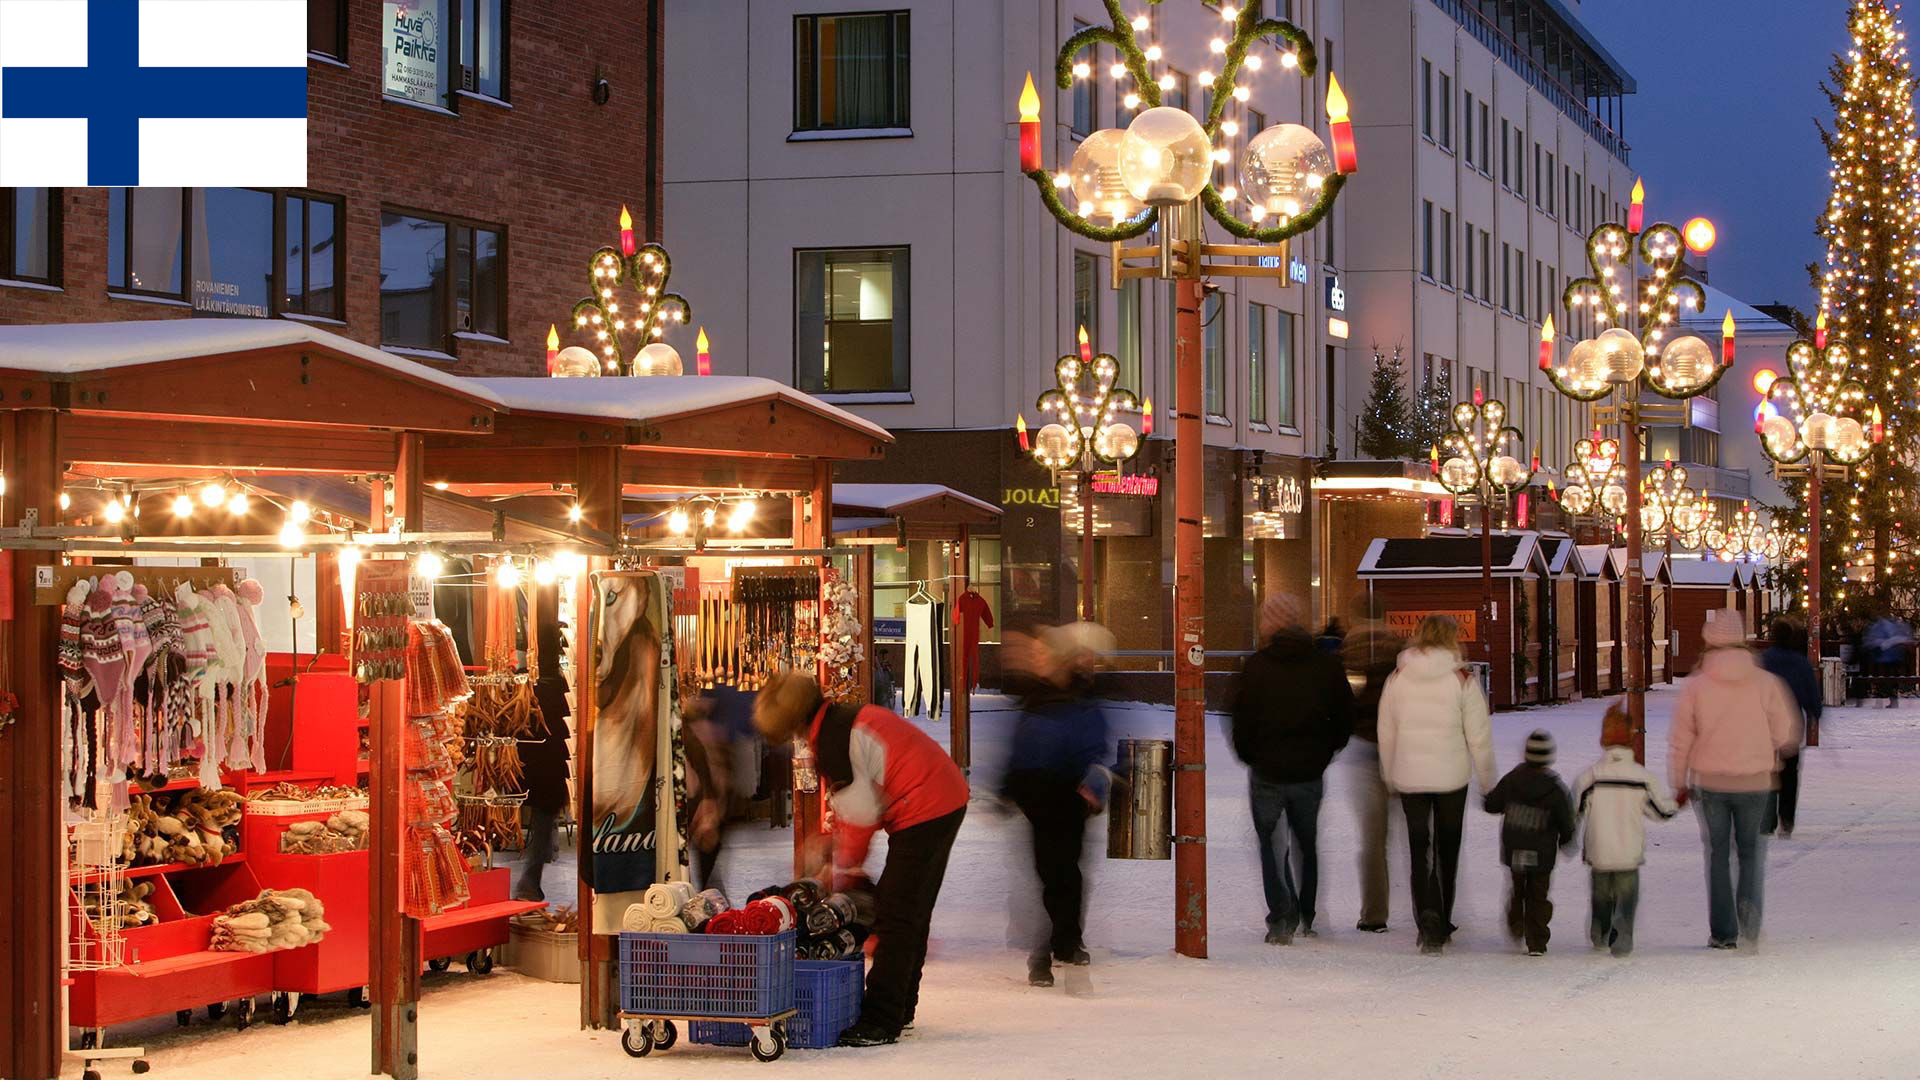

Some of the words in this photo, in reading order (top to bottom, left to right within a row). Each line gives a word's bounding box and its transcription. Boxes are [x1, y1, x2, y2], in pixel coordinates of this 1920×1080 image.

[396, 13, 423, 32] Hyvä
[395, 36, 436, 63] Paikka
[404, 85, 426, 97] DENTIST
[195, 280, 240, 296] ROVANIEMEN
[1026, 516, 1035, 528] 2
